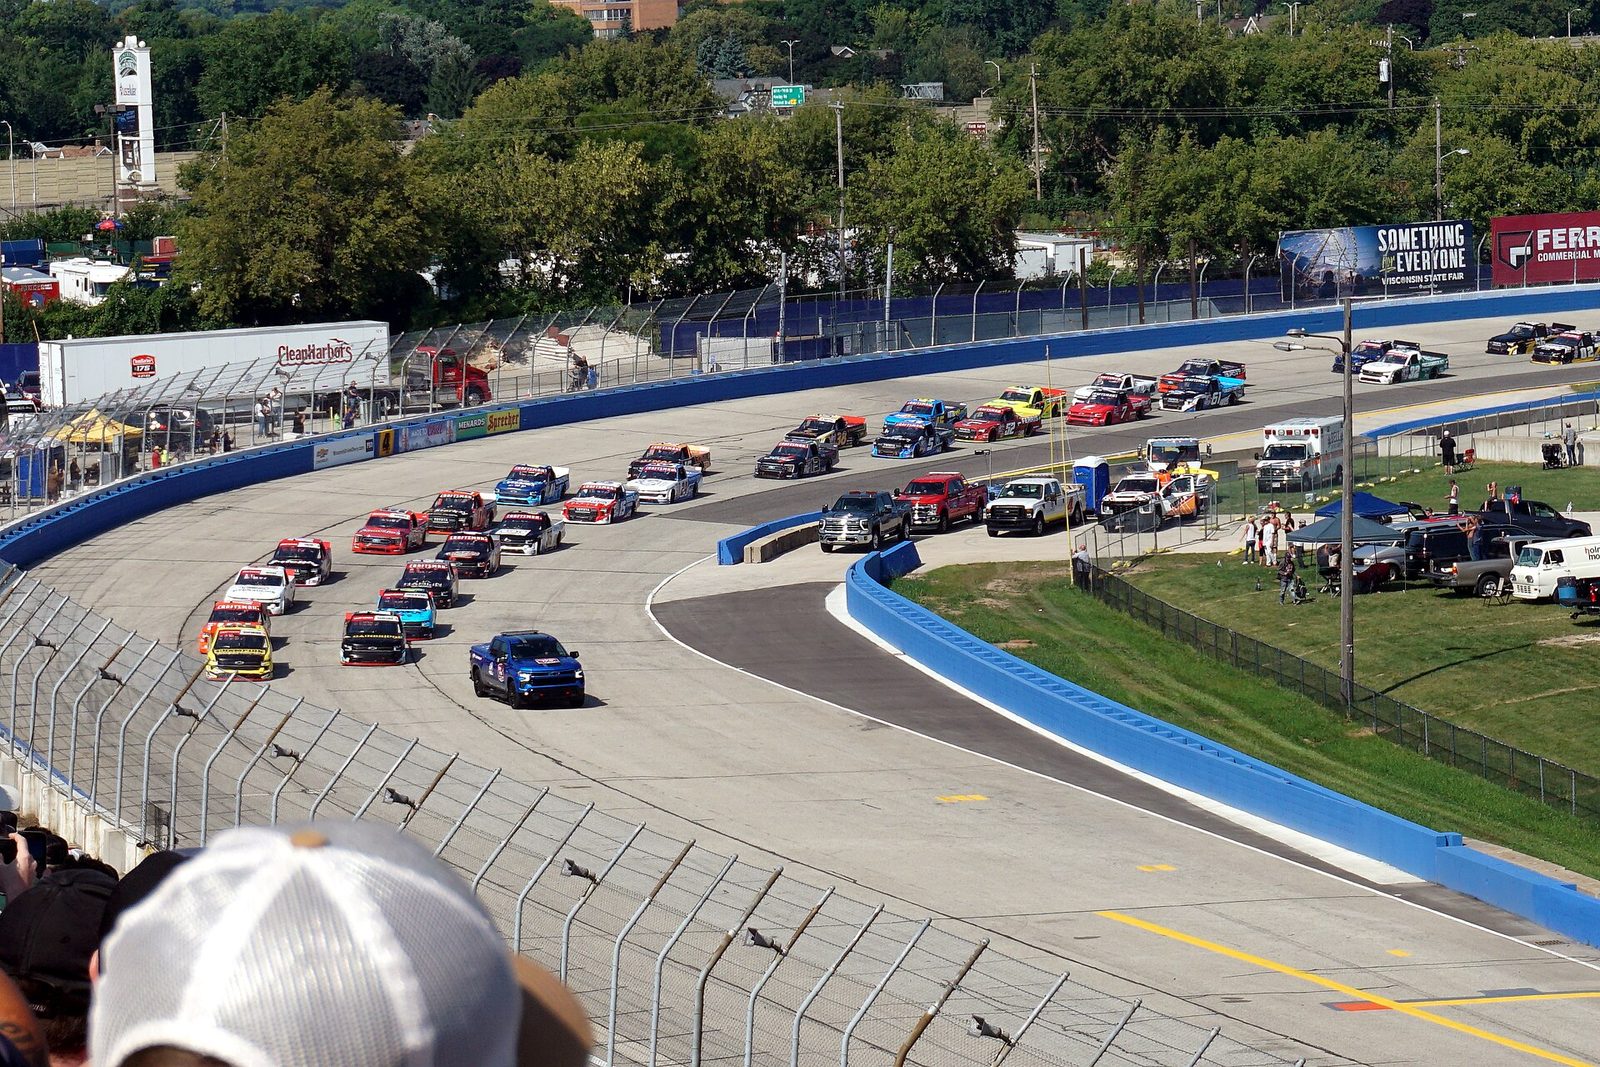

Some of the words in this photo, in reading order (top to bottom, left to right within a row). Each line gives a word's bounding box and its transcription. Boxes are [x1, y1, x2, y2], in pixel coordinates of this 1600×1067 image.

[1378, 224, 1465, 252] SOMETHING
[1537, 226, 1600, 250] FERR
[1397, 248, 1466, 272] EVERYONE
[1537, 250, 1591, 262] COMMERCIAL
[1382, 275, 1423, 285] WISCONSIN
[1424, 273, 1447, 282] STATE
[1448, 272, 1464, 281] FAIR
[277, 343, 353, 367] CleanHarbors
[487, 411, 519, 431] Sprecher
[1121, 405, 1128, 419] 7
[458, 418, 485, 430] MENARDS
